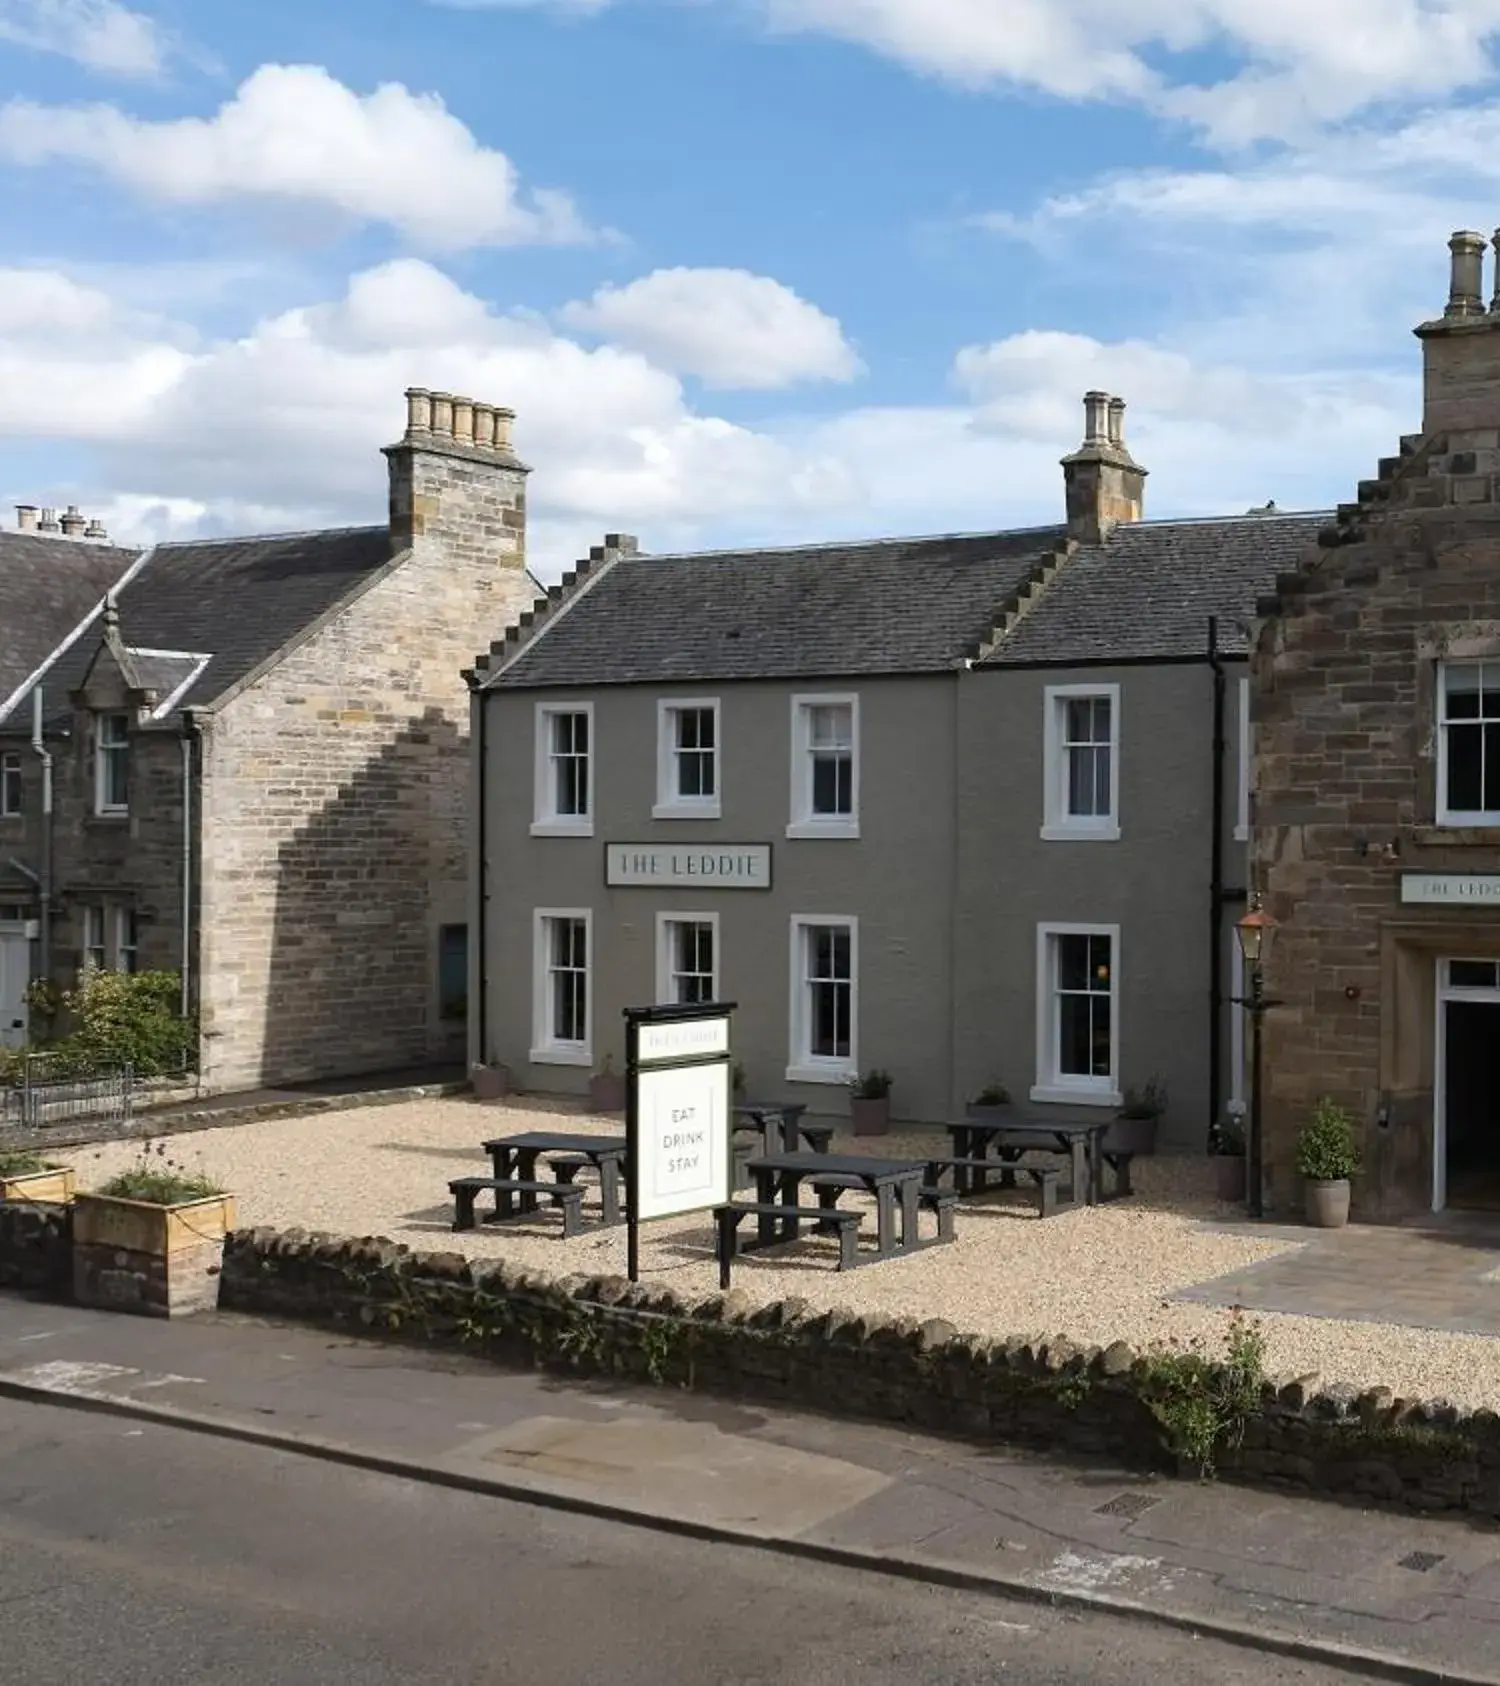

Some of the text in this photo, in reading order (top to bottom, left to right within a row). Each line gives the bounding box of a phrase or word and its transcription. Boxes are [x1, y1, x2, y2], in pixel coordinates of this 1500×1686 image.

[621, 854, 760, 876] THE LEDDIE
[671, 1107, 696, 1123] EAT
[663, 1131, 704, 1149] DRINK
[668, 1154, 699, 1173] STAY
